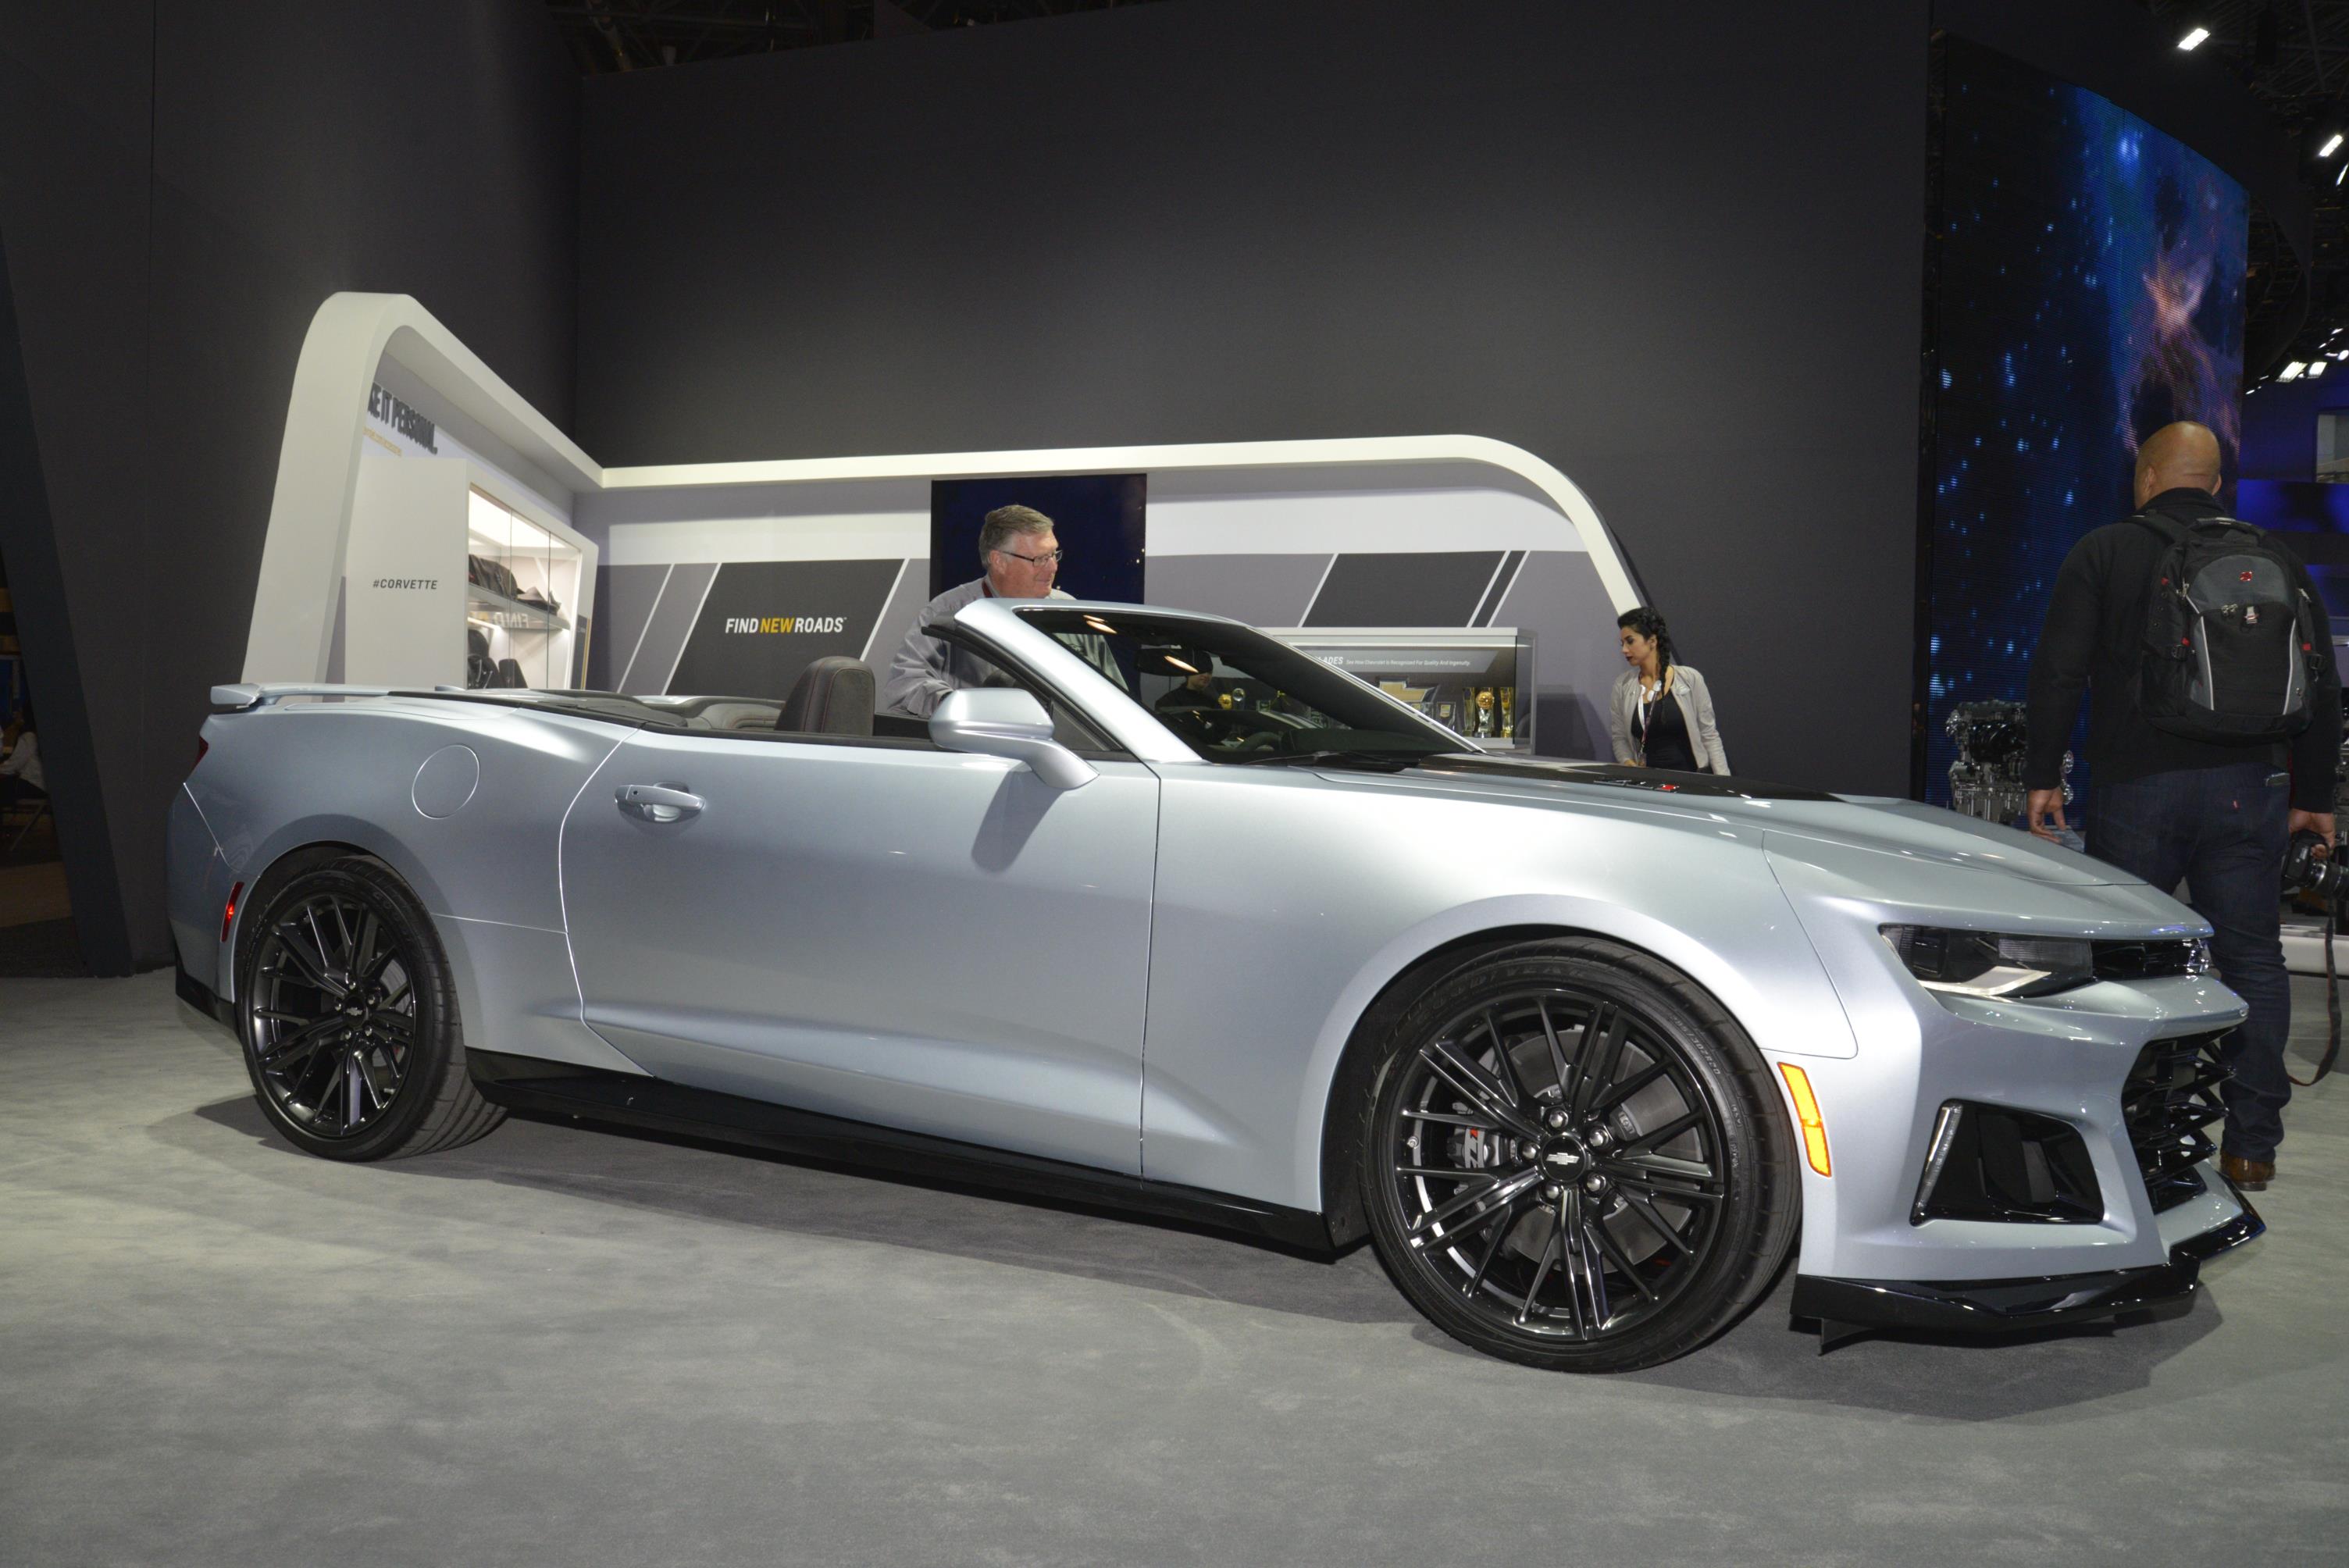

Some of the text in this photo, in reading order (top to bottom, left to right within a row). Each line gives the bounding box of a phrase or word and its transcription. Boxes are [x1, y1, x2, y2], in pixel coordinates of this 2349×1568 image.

[372, 579, 438, 590] #CORVETTE
[725, 618, 759, 633] FIND
[760, 618, 795, 633] NEW
